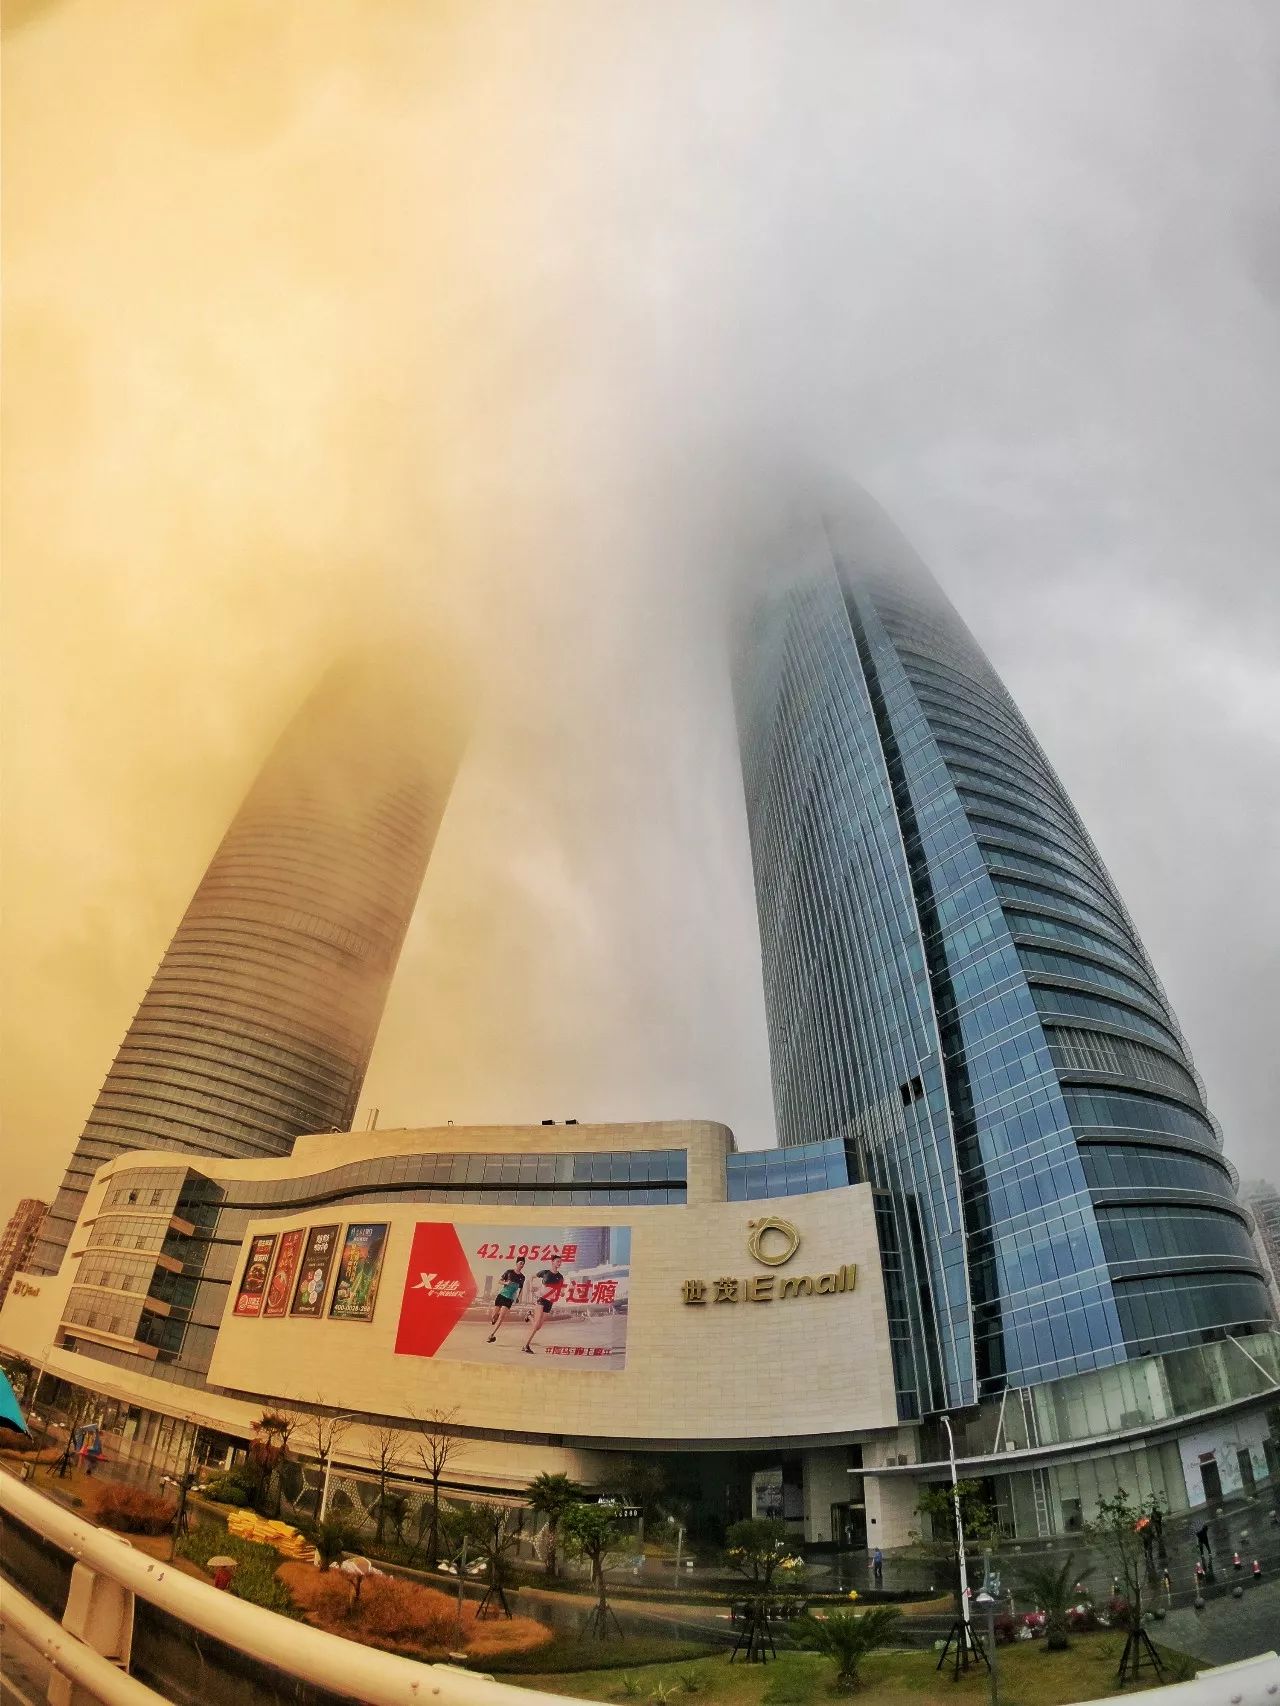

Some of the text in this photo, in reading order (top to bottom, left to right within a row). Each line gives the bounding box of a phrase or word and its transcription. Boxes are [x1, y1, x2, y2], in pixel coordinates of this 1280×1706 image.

[477, 1243, 577, 1262] 42.195公里
[543, 1280, 618, 1304] 才过瘾
[681, 1263, 857, 1305] 世茂 Emall
